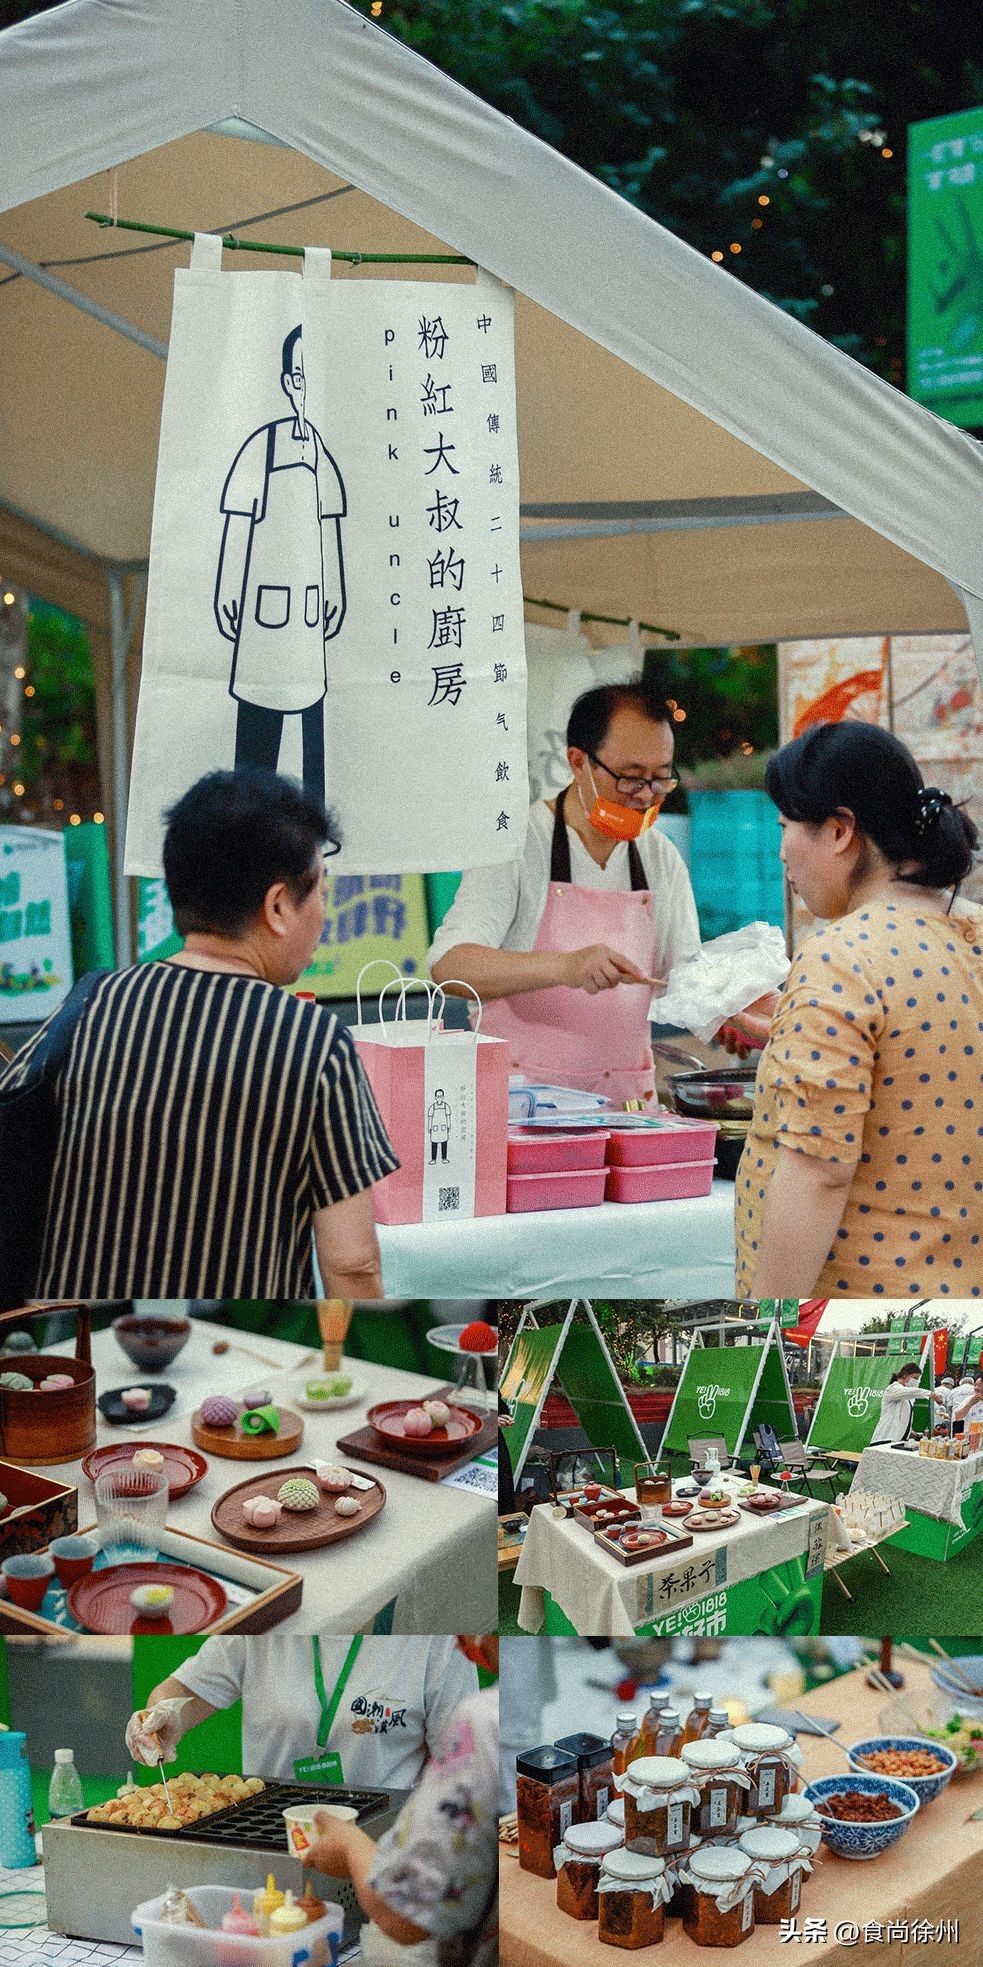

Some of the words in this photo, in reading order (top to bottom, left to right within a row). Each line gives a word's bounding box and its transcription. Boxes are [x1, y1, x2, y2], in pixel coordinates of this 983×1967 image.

[384, 329, 399, 460] pink
[418, 315, 467, 706] 粉紅大叔的廚房
[388, 515, 401, 685] uncle
[652, 1612, 682, 1636] YE!
[702, 1592, 727, 1616] 1818
[659, 1560, 715, 1599] 茶果子
